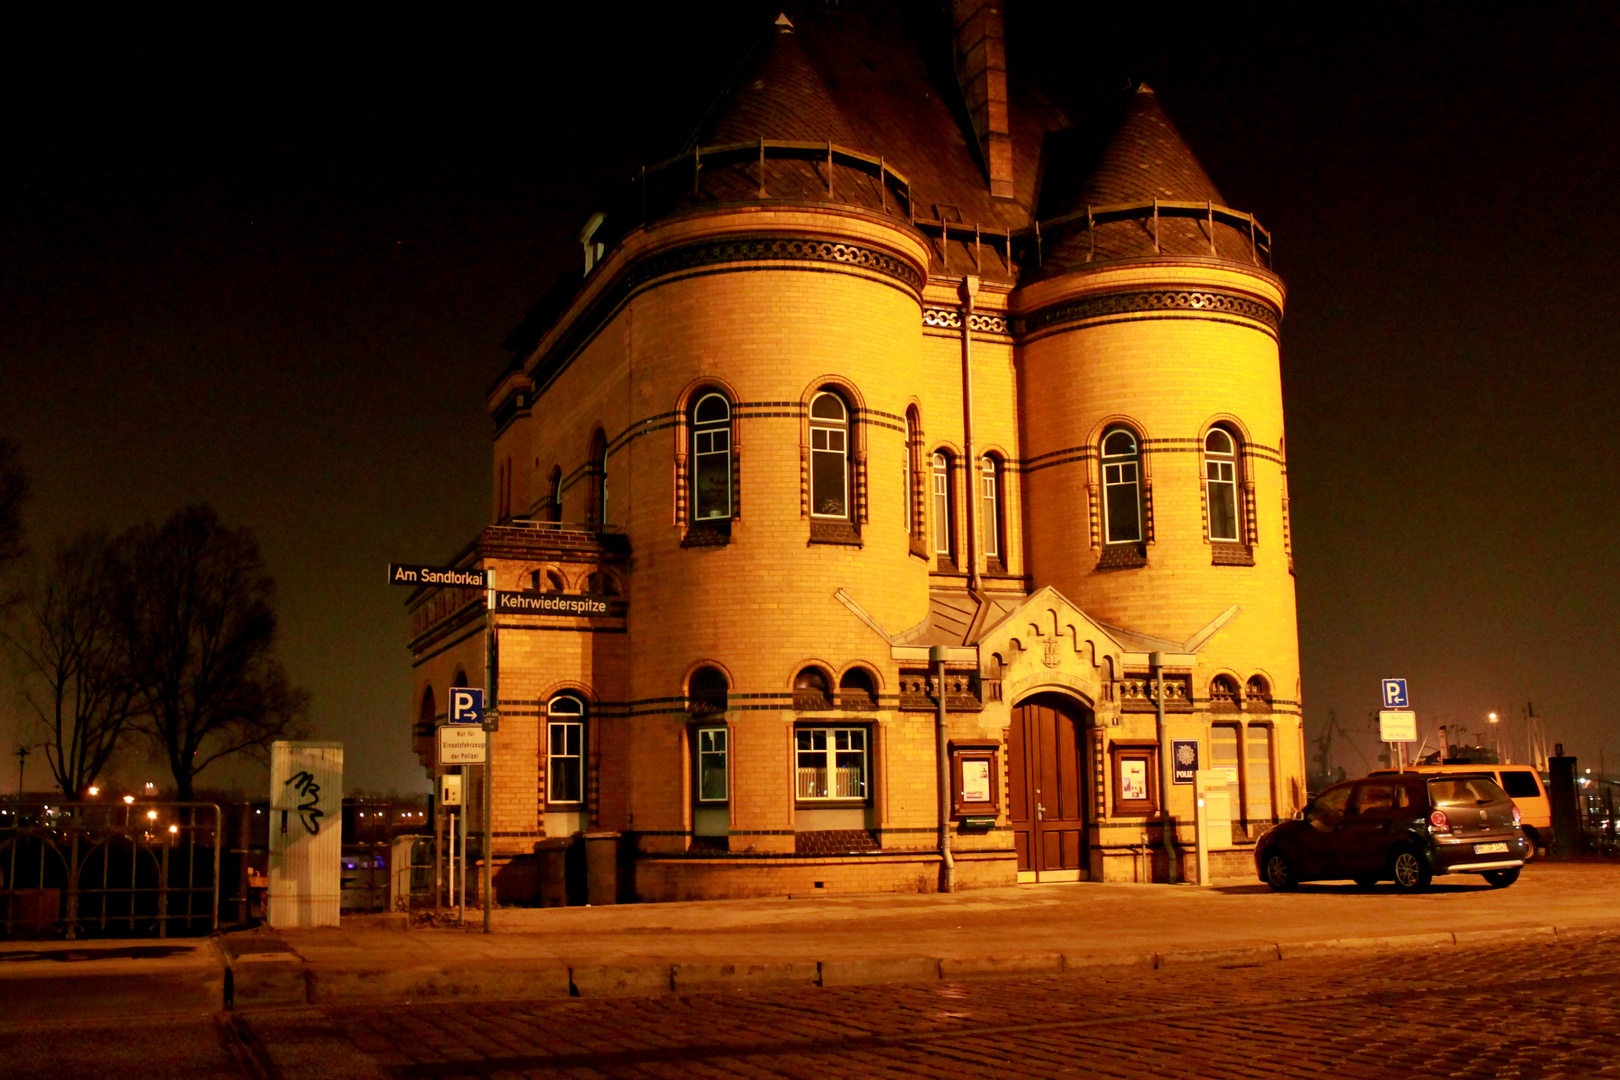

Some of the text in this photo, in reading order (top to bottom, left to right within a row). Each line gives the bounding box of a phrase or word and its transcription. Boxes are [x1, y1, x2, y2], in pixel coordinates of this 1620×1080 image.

[395, 567, 483, 586] Am Sandtorkai
[501, 593, 606, 614] Kehrwiederspitze
[1386, 683, 1400, 704] P
[455, 693, 474, 720] P
[1176, 770, 1193, 778] POLIZ
